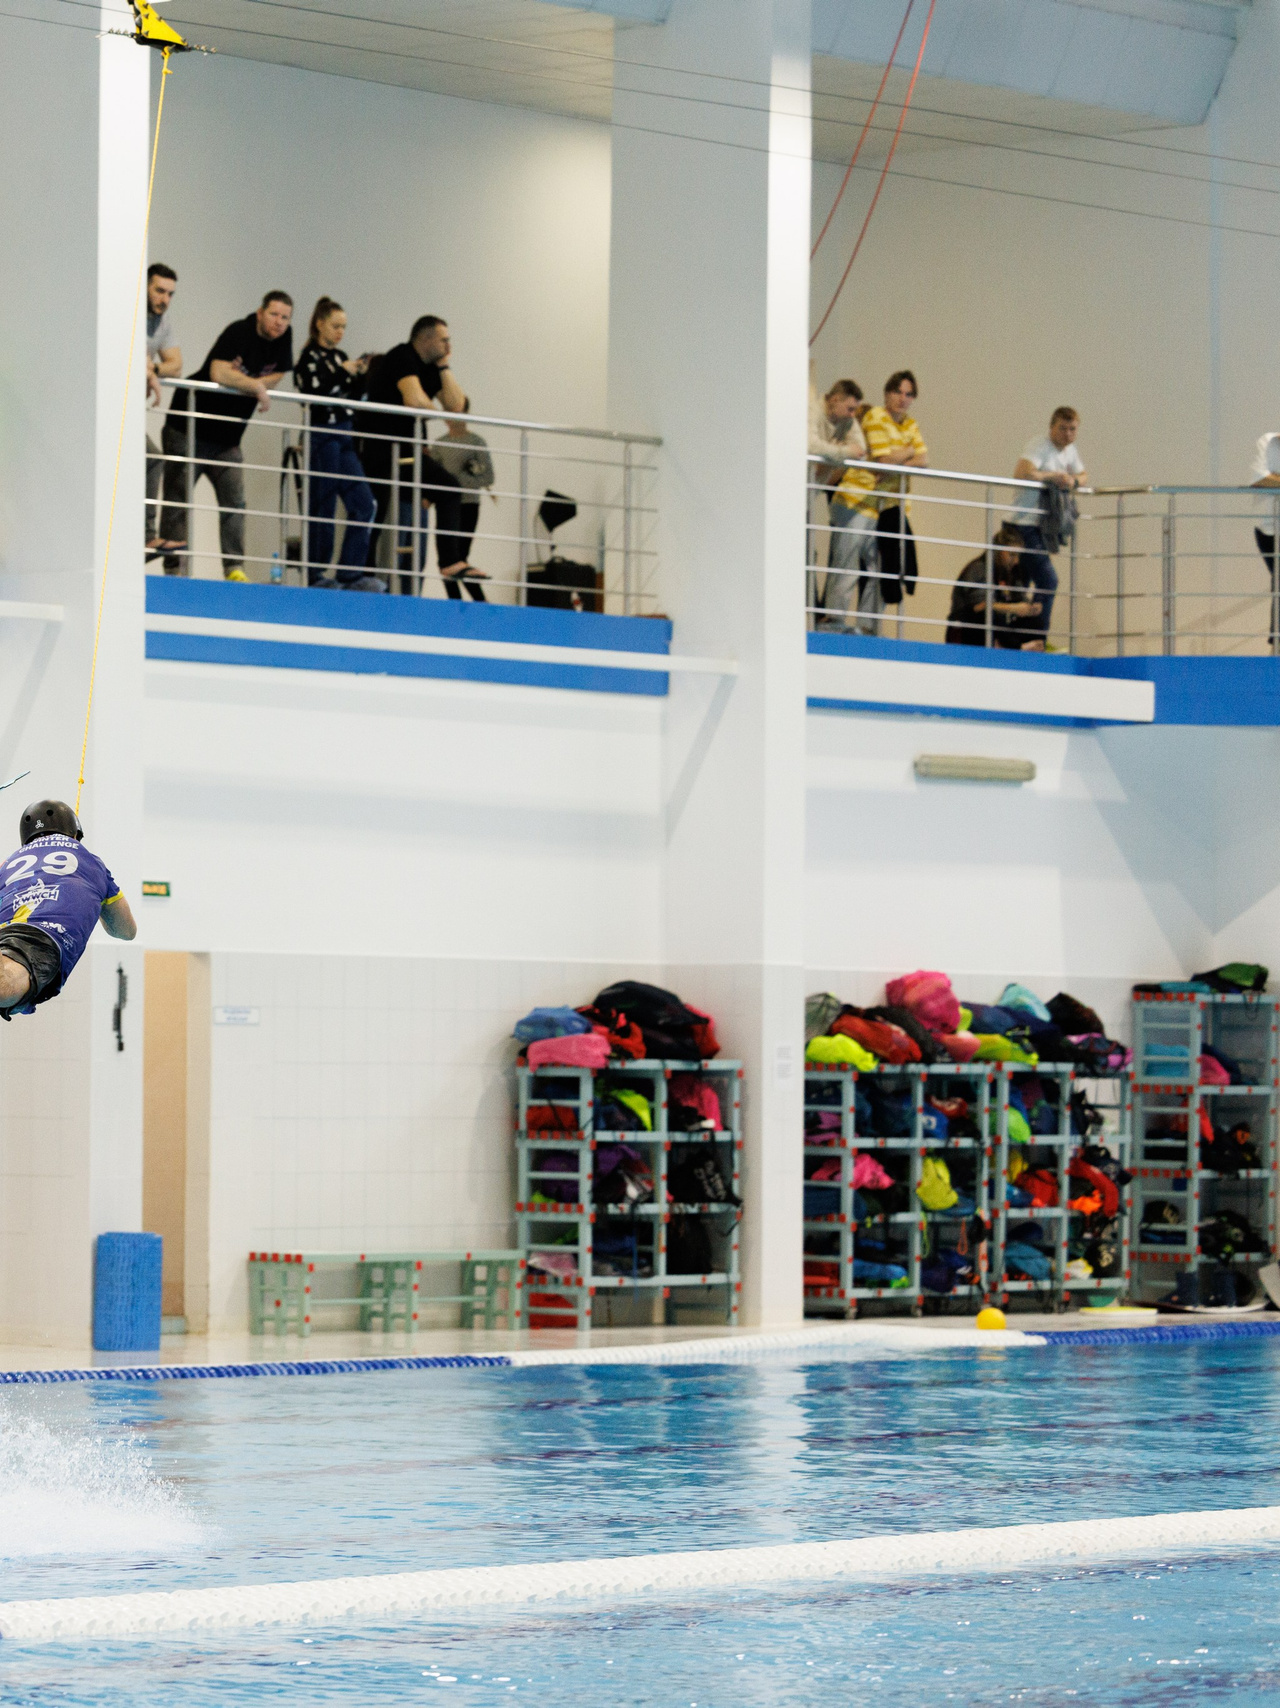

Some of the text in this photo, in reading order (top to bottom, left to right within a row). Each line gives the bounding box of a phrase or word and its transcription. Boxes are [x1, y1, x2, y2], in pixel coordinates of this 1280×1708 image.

[19, 841, 79, 853] CHALLENGE
[5, 851, 79, 887] 29
[14, 891, 57, 909] KWWCH
